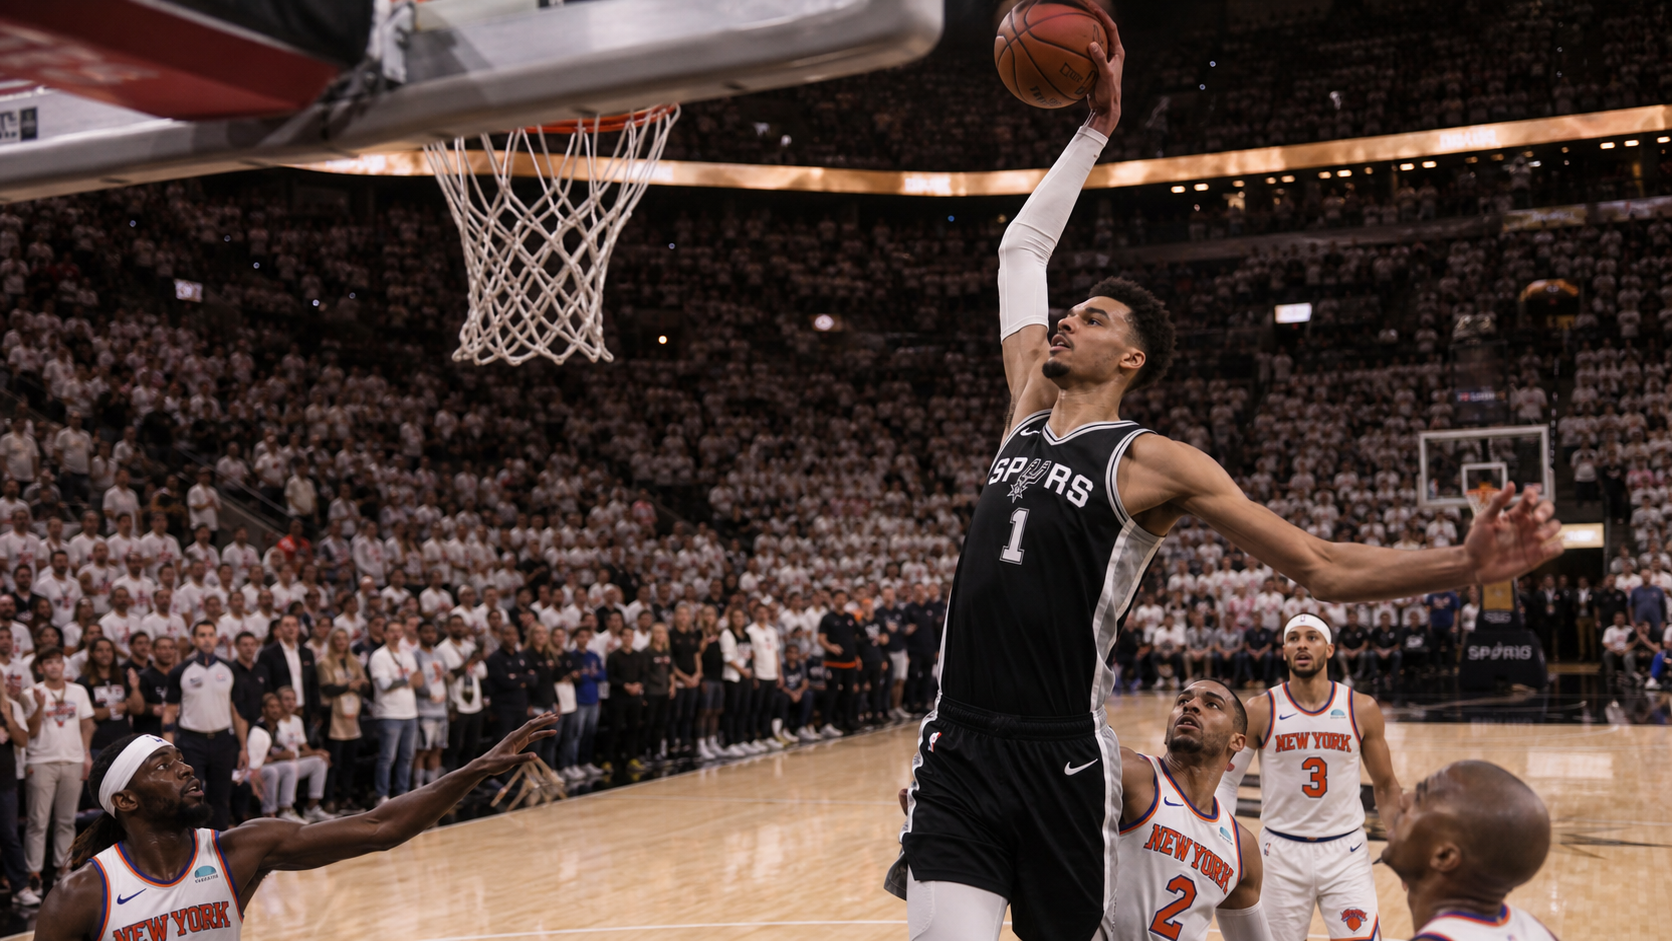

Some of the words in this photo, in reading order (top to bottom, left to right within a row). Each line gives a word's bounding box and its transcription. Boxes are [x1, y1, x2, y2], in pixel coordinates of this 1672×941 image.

[988, 457, 1094, 509] SPURS
[999, 507, 1030, 565] 1
[1275, 732, 1310, 753] NEW
[1311, 731, 1352, 753] YORK
[1301, 756, 1328, 798] 3
[1143, 823, 1194, 862] NEW
[1190, 841, 1234, 895] YORK
[170, 901, 231, 937] YORK
[1148, 874, 1198, 941] 2
